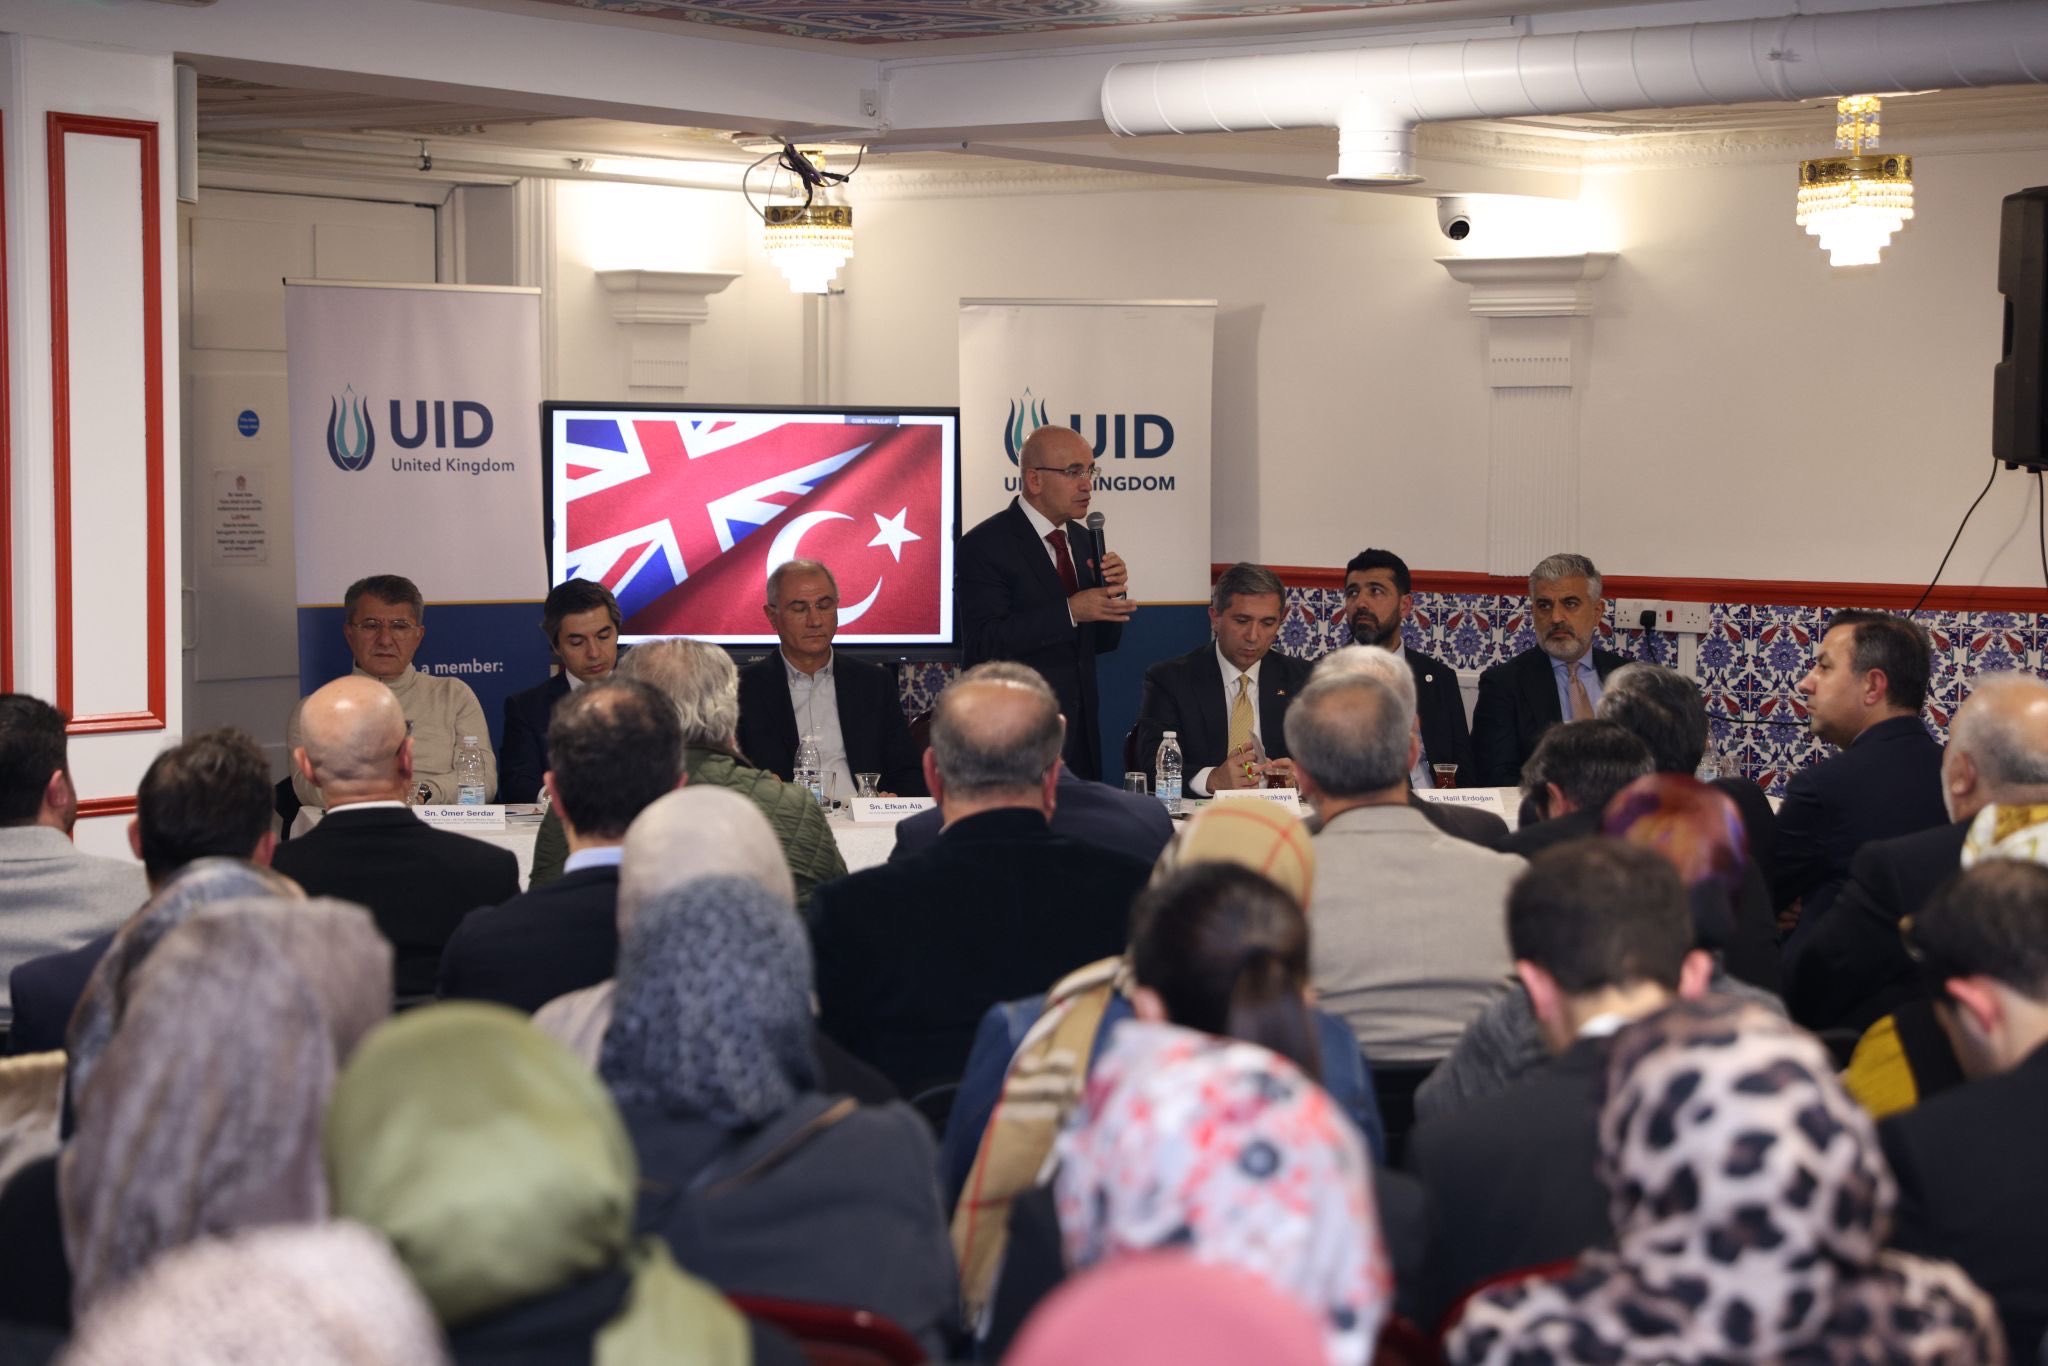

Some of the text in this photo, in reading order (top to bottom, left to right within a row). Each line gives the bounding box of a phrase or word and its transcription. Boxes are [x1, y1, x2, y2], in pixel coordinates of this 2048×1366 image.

[389, 399, 494, 449] UID
[1070, 414, 1175, 460] UID
[391, 457, 515, 475] United Kingdom
[1092, 476, 1175, 491] INGDOM
[421, 658, 504, 674] a member:
